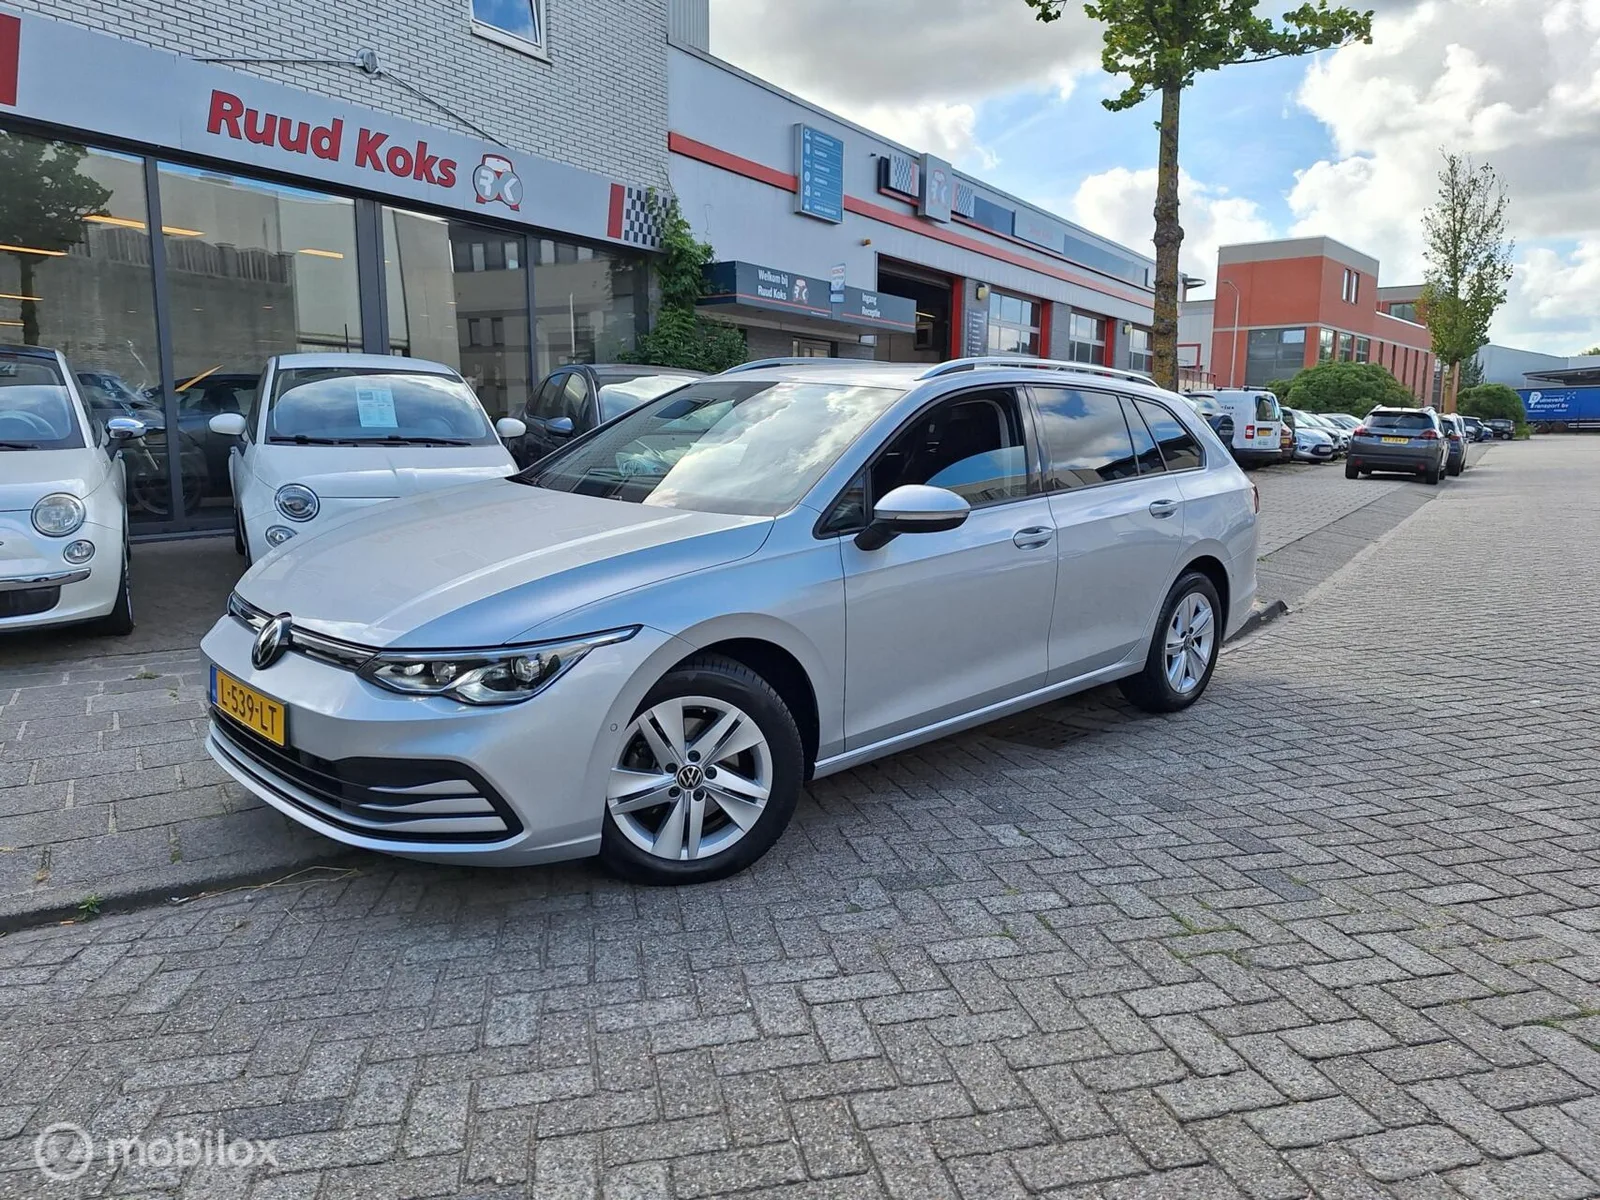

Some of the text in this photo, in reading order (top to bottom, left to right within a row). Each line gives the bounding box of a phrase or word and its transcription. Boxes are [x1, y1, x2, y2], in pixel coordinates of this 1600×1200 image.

[207, 89, 457, 188] Ruud Koks
[758, 269, 789, 288] Welkom bij
[758, 285, 787, 300] Ruud Koks
[220, 678, 277, 735] L-539-LT
